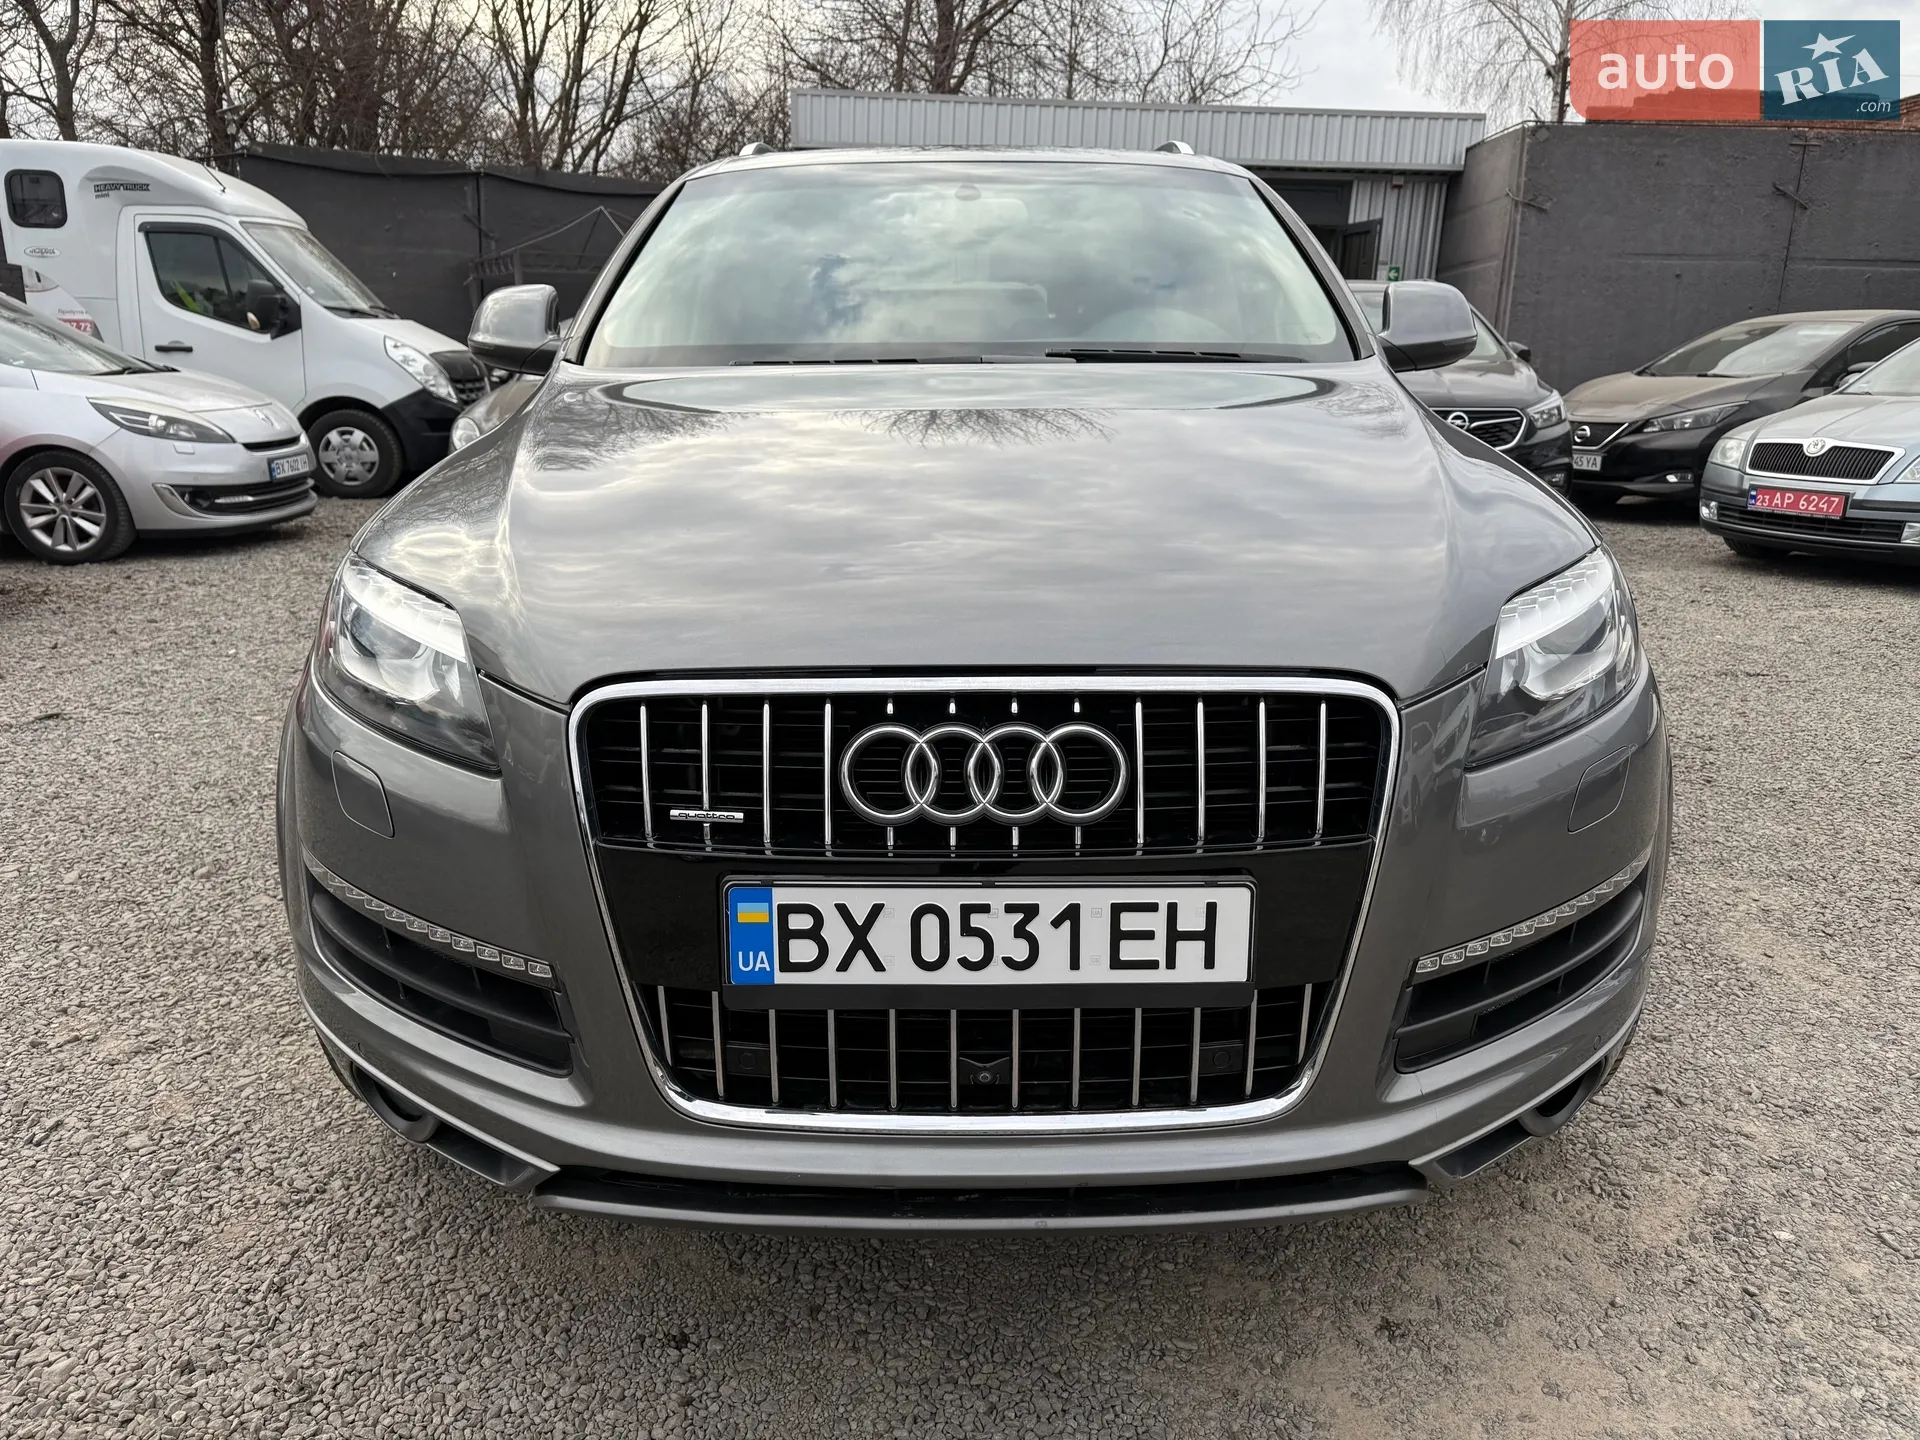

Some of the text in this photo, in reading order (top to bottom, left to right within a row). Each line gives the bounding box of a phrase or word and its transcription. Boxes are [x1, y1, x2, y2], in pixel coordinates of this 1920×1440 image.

[121, 183, 151, 191] TRUCK
[1756, 492, 1839, 512] 23 AP 6247
[776, 901, 1218, 973] BX 0531 EH
[738, 951, 771, 972] UA
